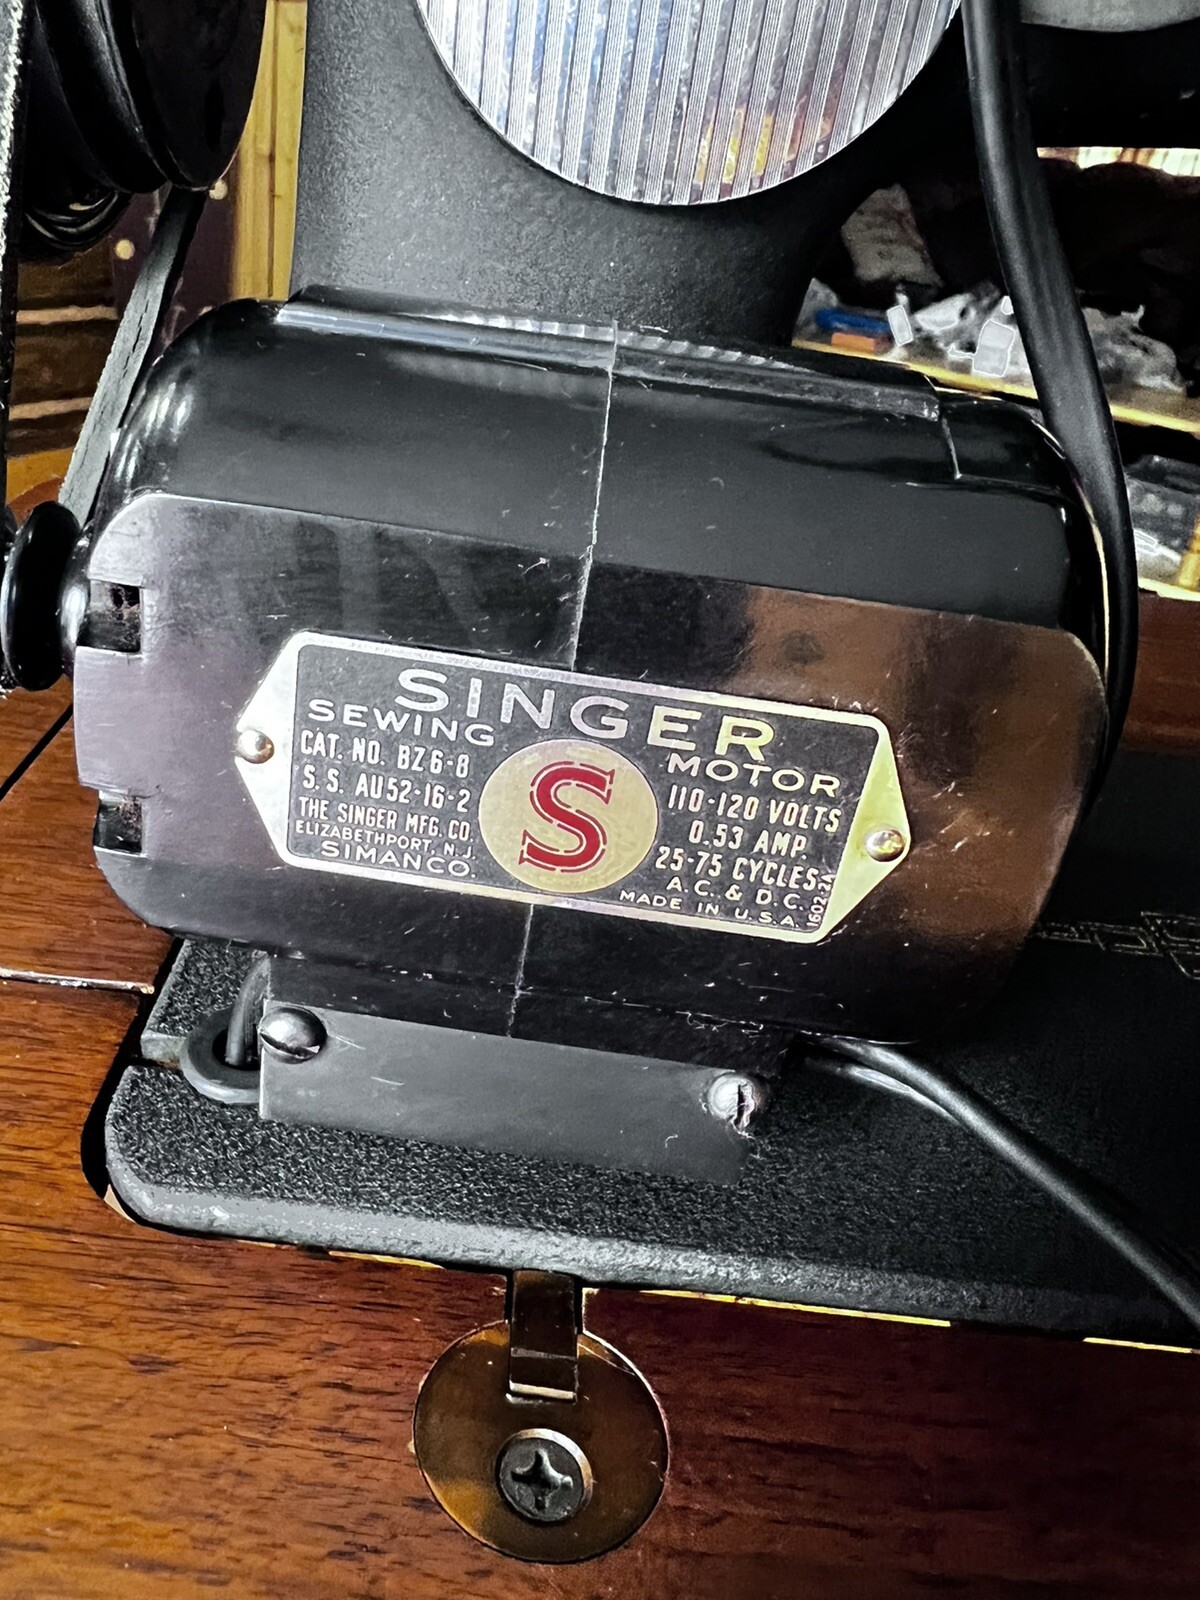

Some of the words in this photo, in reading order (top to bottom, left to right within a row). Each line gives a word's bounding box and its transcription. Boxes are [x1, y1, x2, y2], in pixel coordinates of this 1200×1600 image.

[394, 668, 775, 761] SINGER
[300, 729, 343, 760] CAT.
[352, 738, 386, 765] NO.
[397, 745, 470, 778] BZ6-8
[308, 699, 495, 747] SEWING
[667, 753, 840, 797] MOTOR
[355, 773, 471, 813] AU52-16-2
[668, 785, 760, 821] 110-120
[769, 799, 842, 833] VOLTS
[296, 820, 436, 854] ELIZABETHPORT,
[298, 796, 329, 820] THE
[337, 803, 397, 830] SINGER
[405, 812, 443, 838] MFG.
[448, 821, 474, 843] CO.
[519, 761, 615, 873] S
[689, 820, 744, 849] 0.53
[754, 830, 807, 860] AMP.
[320, 840, 477, 878] SIMANCO.
[655, 845, 722, 878] 25-75
[732, 857, 819, 891] CYCLES
[620, 890, 683, 909] MADE
[698, 902, 719, 915] IN
[725, 885, 742, 900] &
